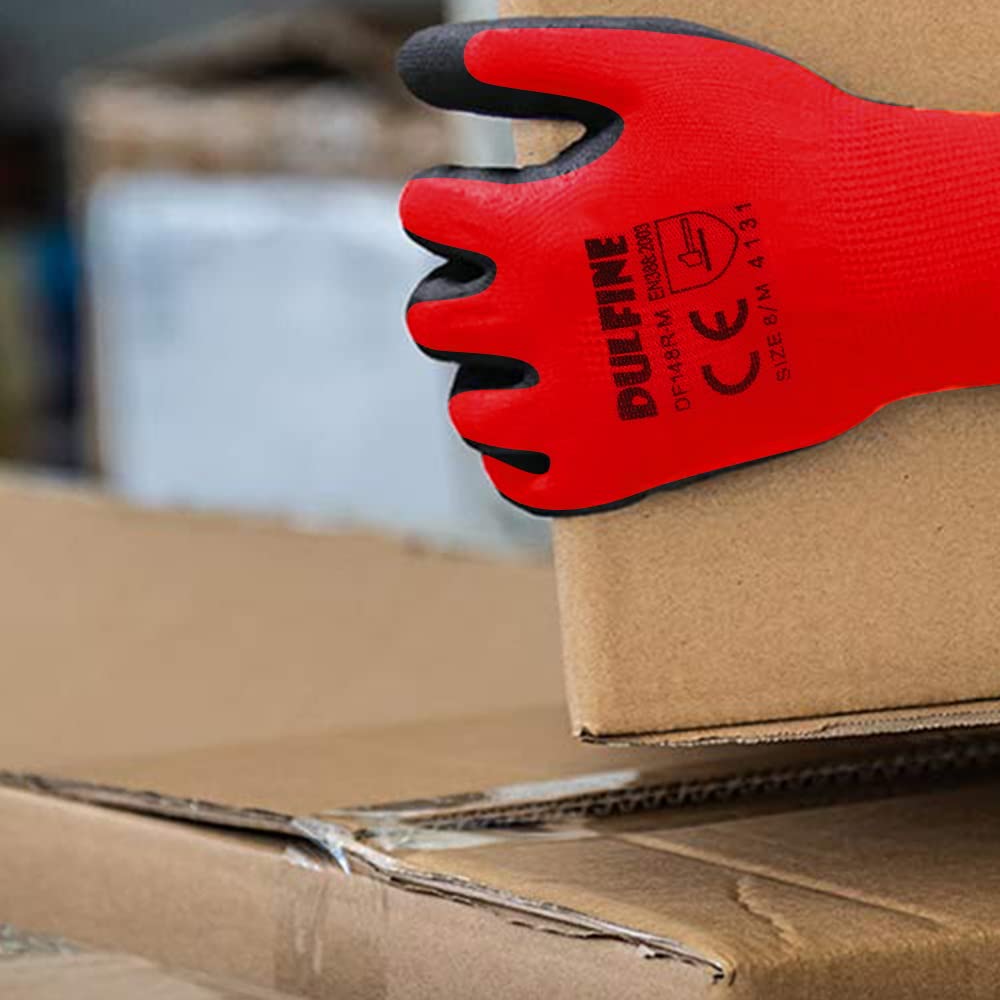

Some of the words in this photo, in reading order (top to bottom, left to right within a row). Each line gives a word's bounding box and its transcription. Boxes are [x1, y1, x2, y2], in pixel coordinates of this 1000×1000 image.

[584, 235, 658, 421] DULFINE
[688, 298, 760, 395] CE
[755, 283, 778, 326] 8/M
[654, 309, 691, 411] DF148R-M
[767, 332, 791, 382] SIZE
